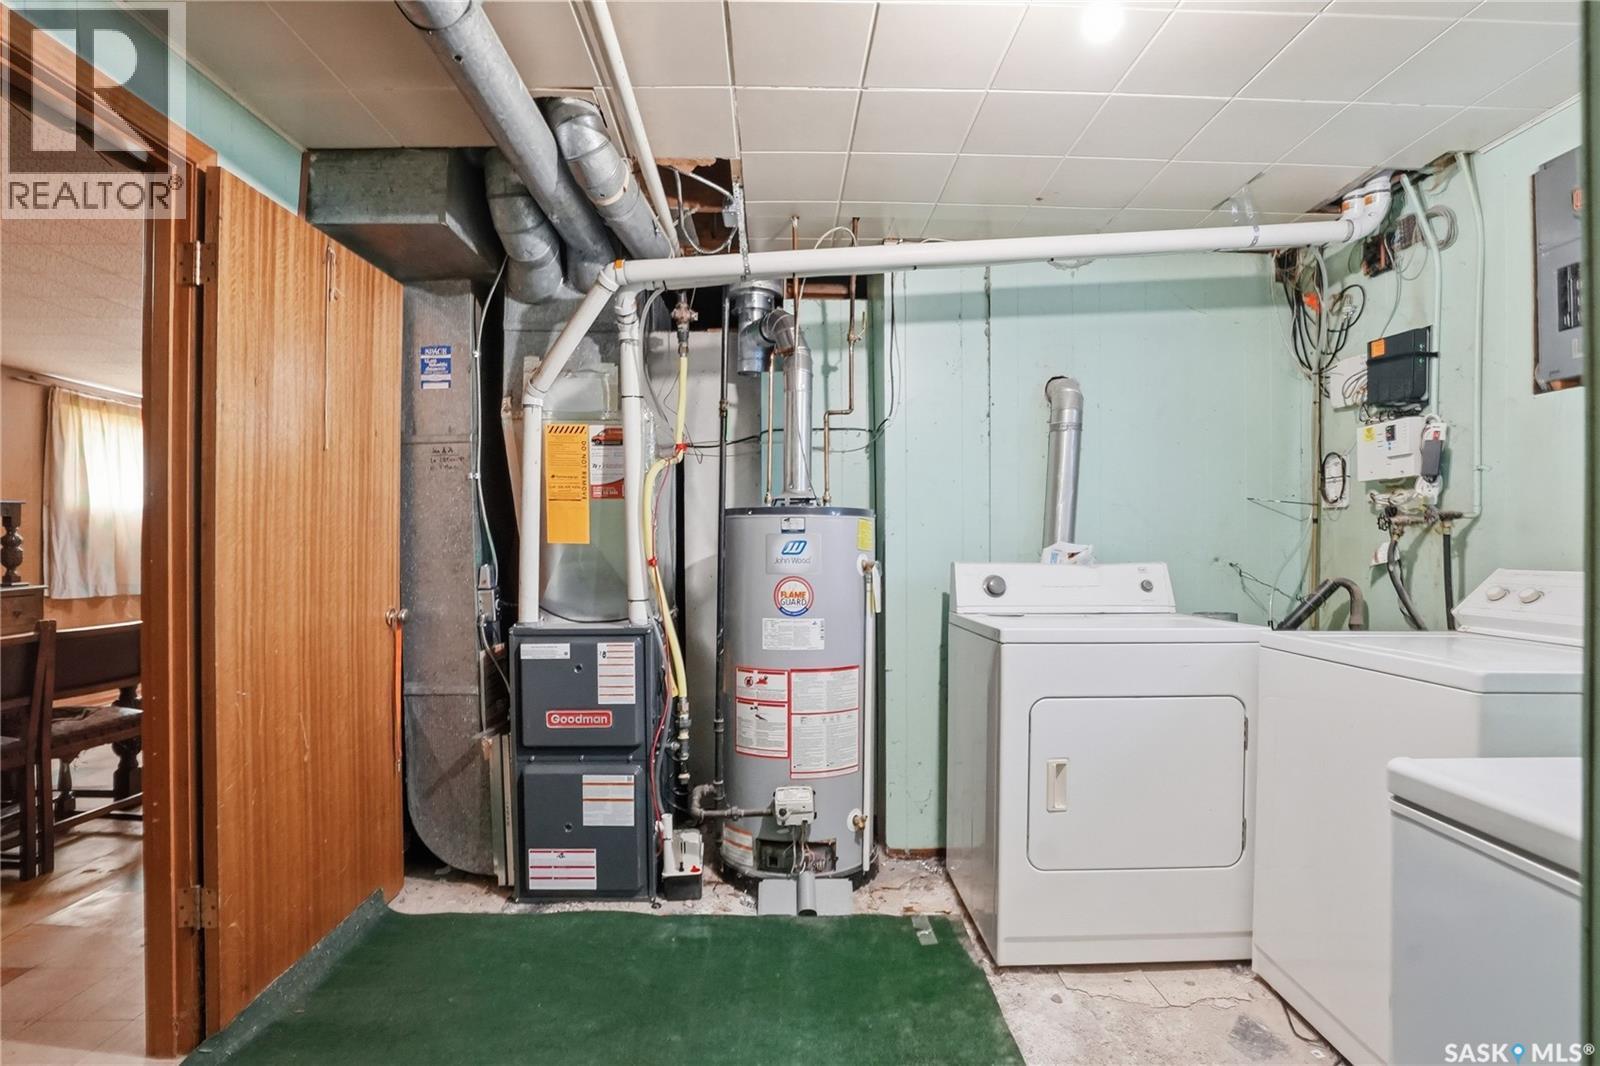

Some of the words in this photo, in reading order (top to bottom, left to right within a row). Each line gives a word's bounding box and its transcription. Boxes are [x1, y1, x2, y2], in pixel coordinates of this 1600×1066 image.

[581, 440, 587, 451] DO
[780, 591, 806, 599] FLAME
[551, 714, 608, 724] Goodman
